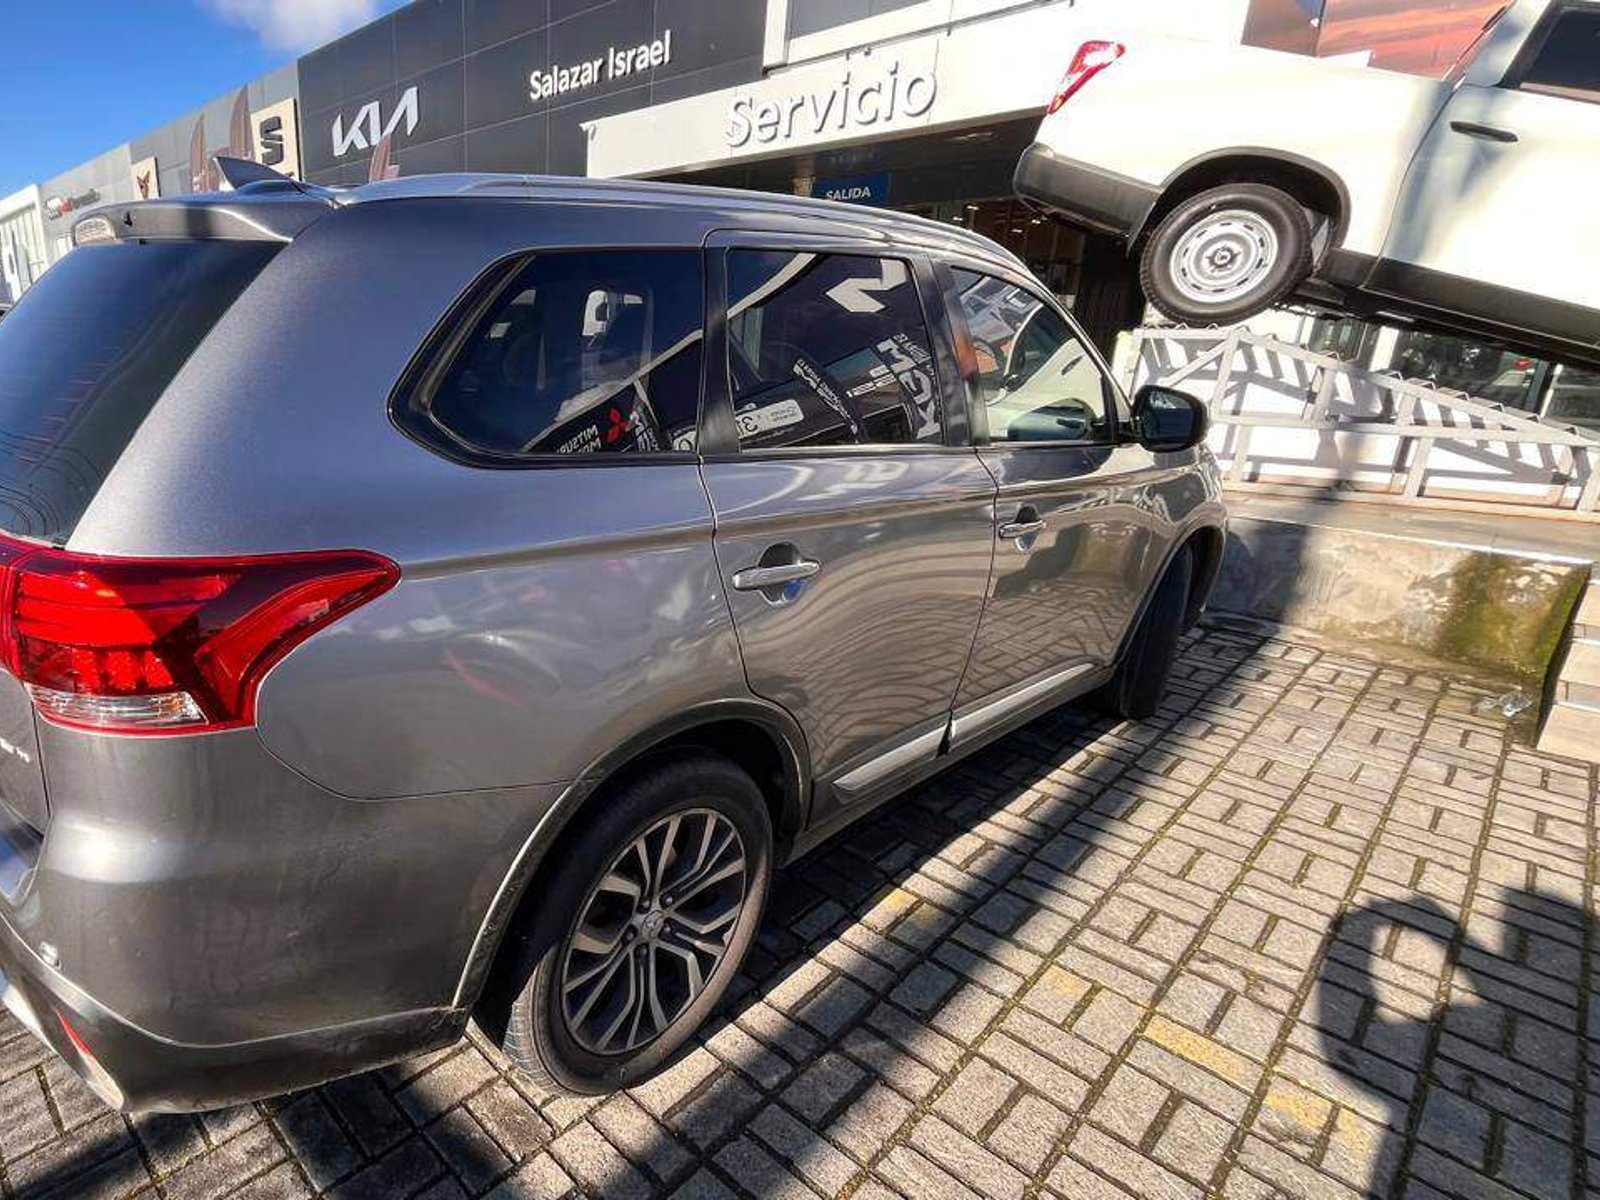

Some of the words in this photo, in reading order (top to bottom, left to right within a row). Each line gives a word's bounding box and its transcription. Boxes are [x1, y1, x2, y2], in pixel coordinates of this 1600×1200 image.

[529, 64, 603, 101] Salazar
[608, 29, 671, 80] Israel
[725, 58, 938, 148] Servicio
[826, 186, 872, 200] SALIDA
